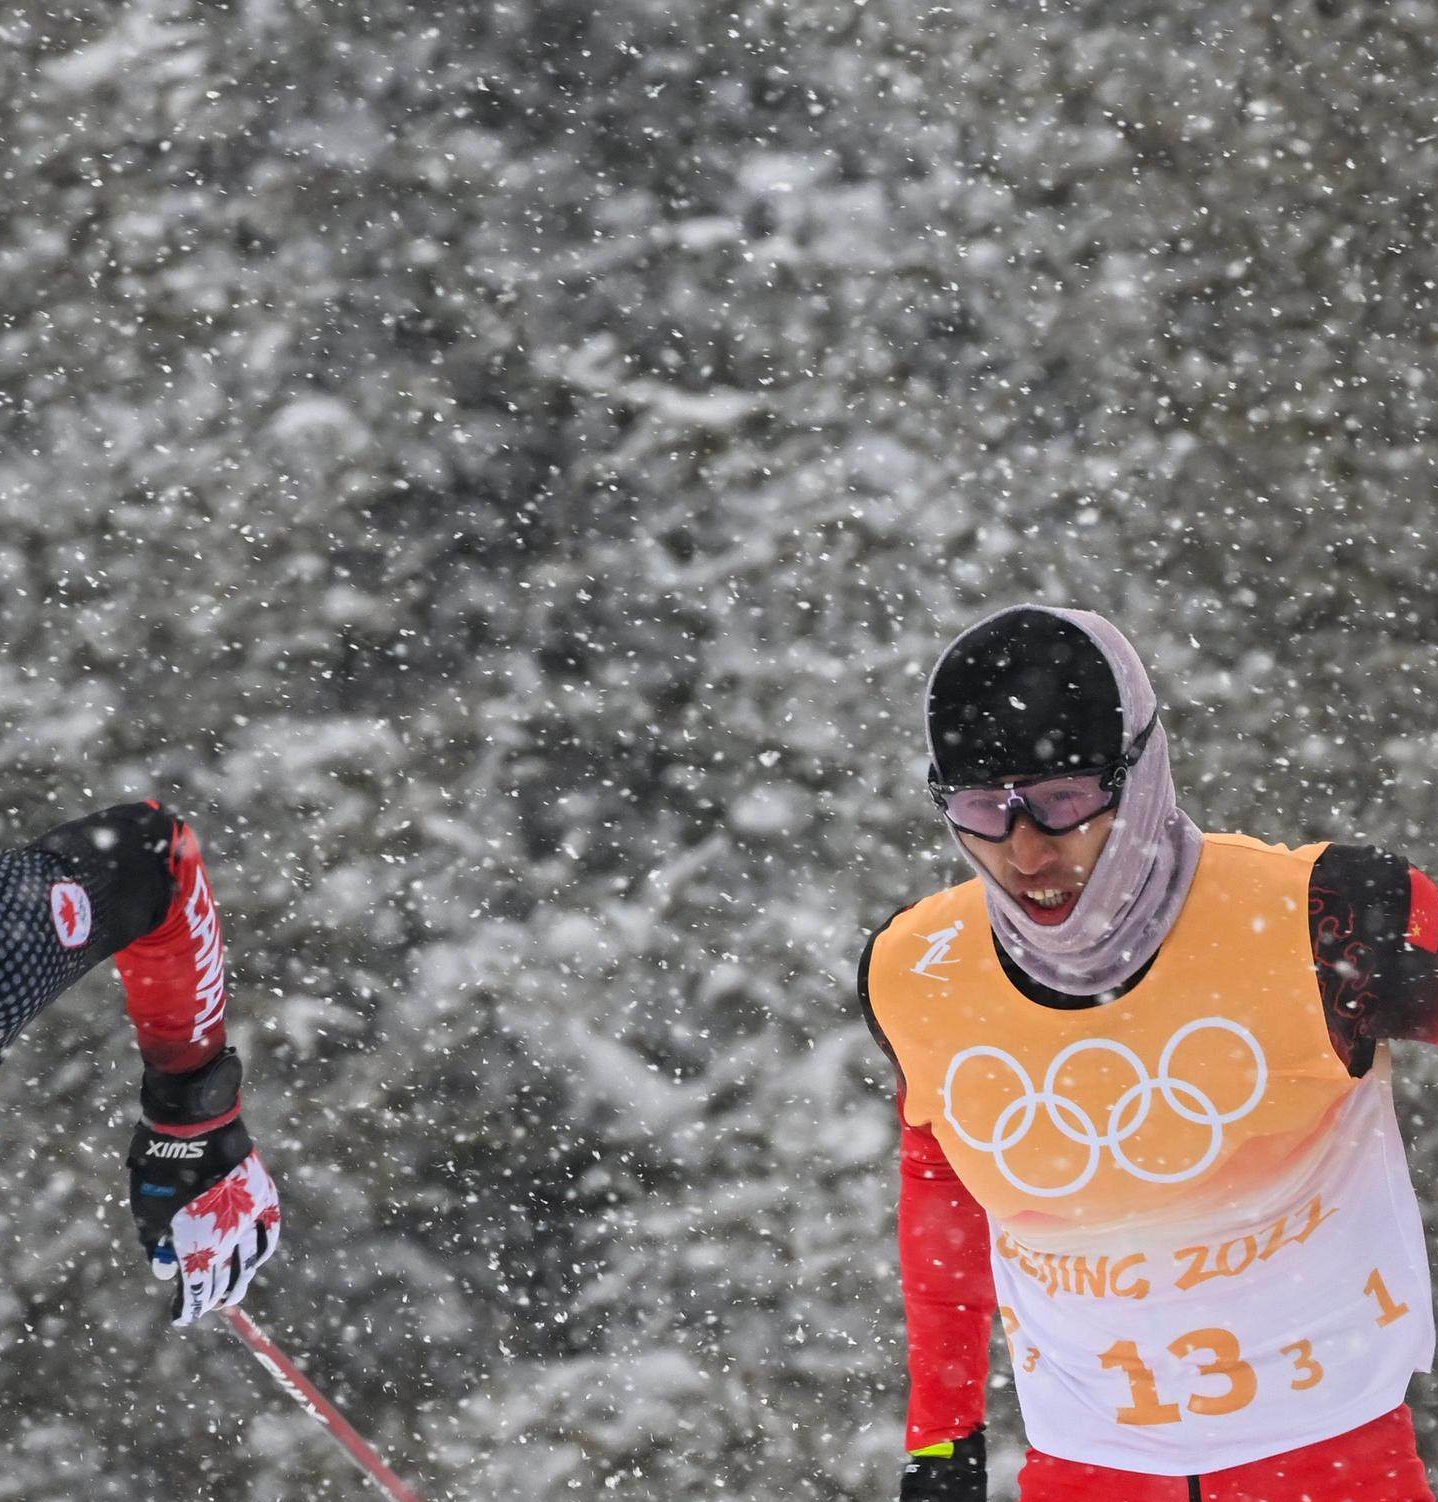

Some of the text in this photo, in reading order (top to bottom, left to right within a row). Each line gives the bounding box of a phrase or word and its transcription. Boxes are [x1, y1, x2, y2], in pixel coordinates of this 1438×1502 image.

[1363, 1268, 1410, 1328] 1
[1096, 1327, 1324, 1425] 13 3
